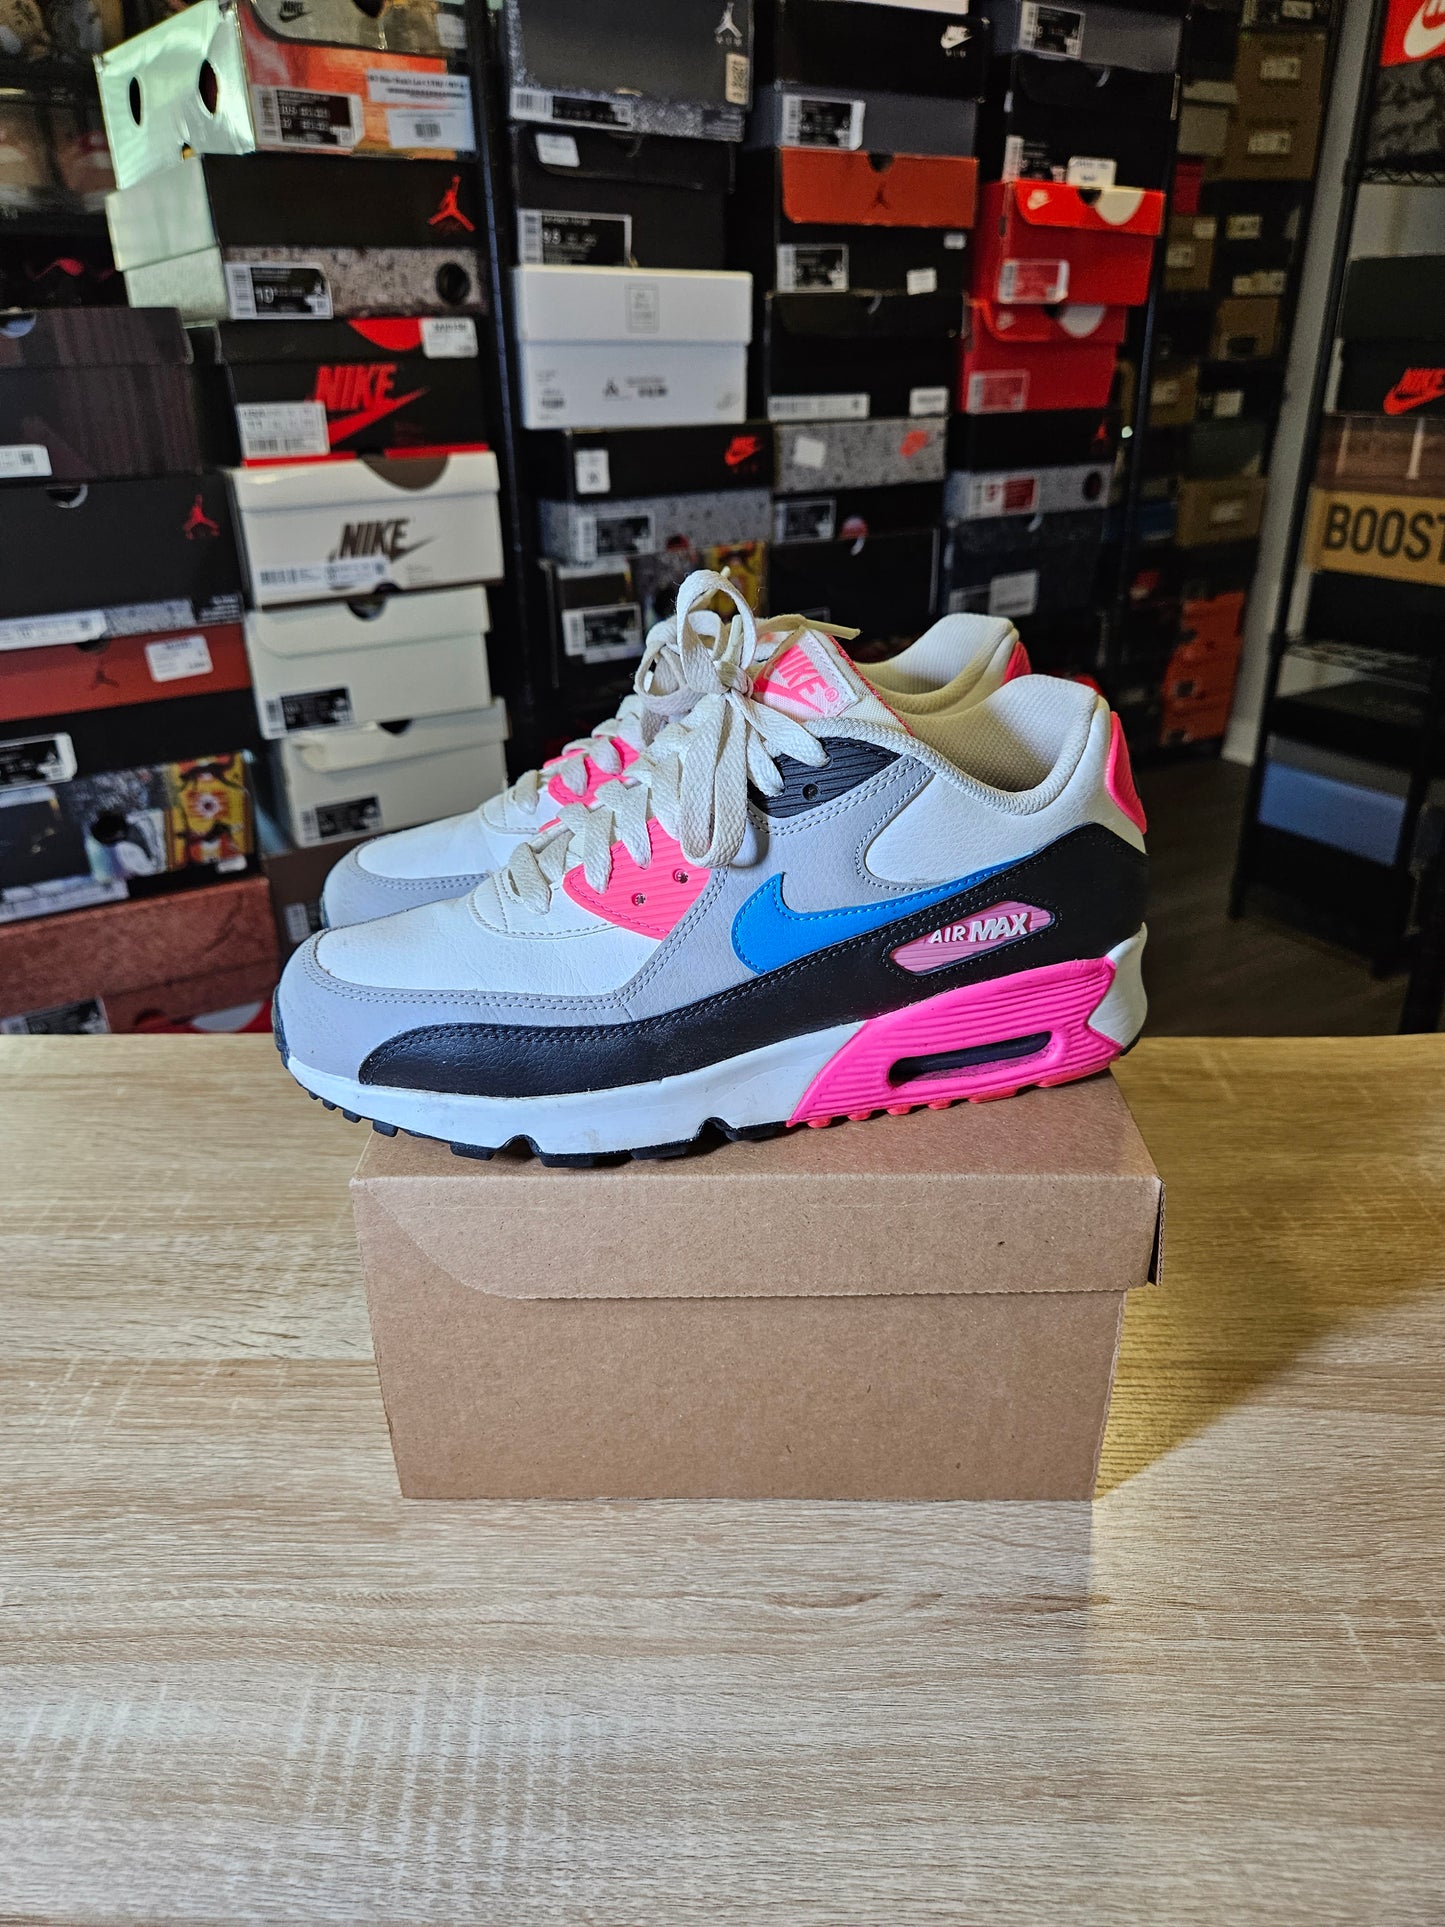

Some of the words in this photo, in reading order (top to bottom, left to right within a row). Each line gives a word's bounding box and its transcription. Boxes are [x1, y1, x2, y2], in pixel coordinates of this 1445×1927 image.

[314, 363, 398, 412] NIKE
[339, 517, 410, 558] NIKE
[776, 645, 829, 697] NIKE
[928, 925, 967, 944] AIR
[969, 912, 1029, 943] MAX
